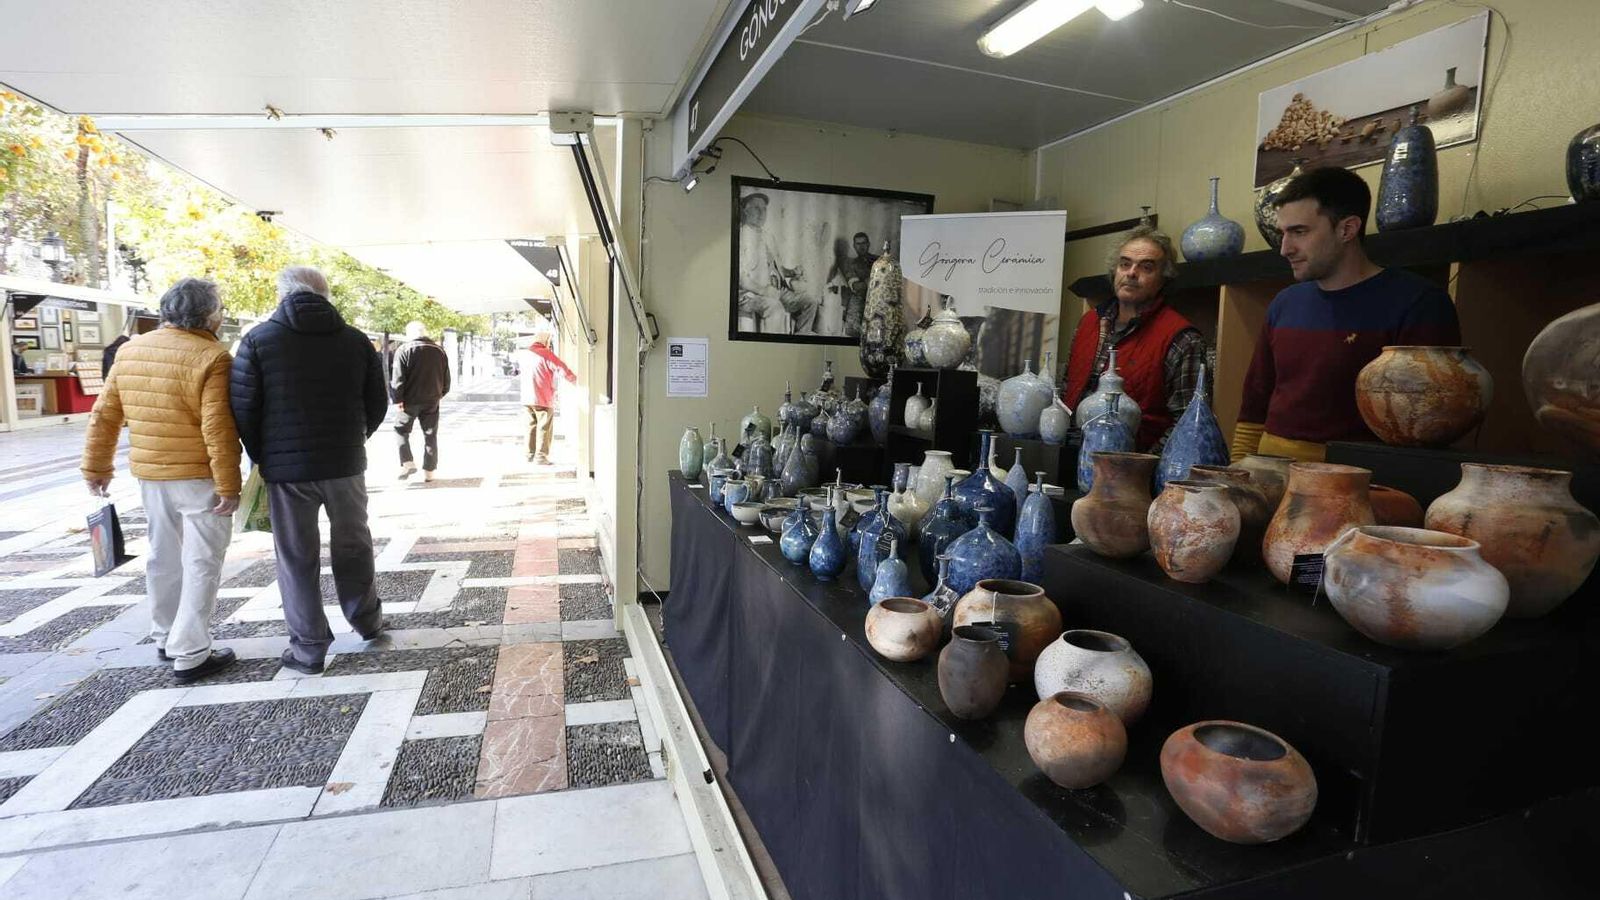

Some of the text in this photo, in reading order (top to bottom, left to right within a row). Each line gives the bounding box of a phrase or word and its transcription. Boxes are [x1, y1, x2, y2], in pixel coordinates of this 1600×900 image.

[740, 0, 786, 61] GÓNG
[918, 238, 1045, 281] Góngora Cerámica
